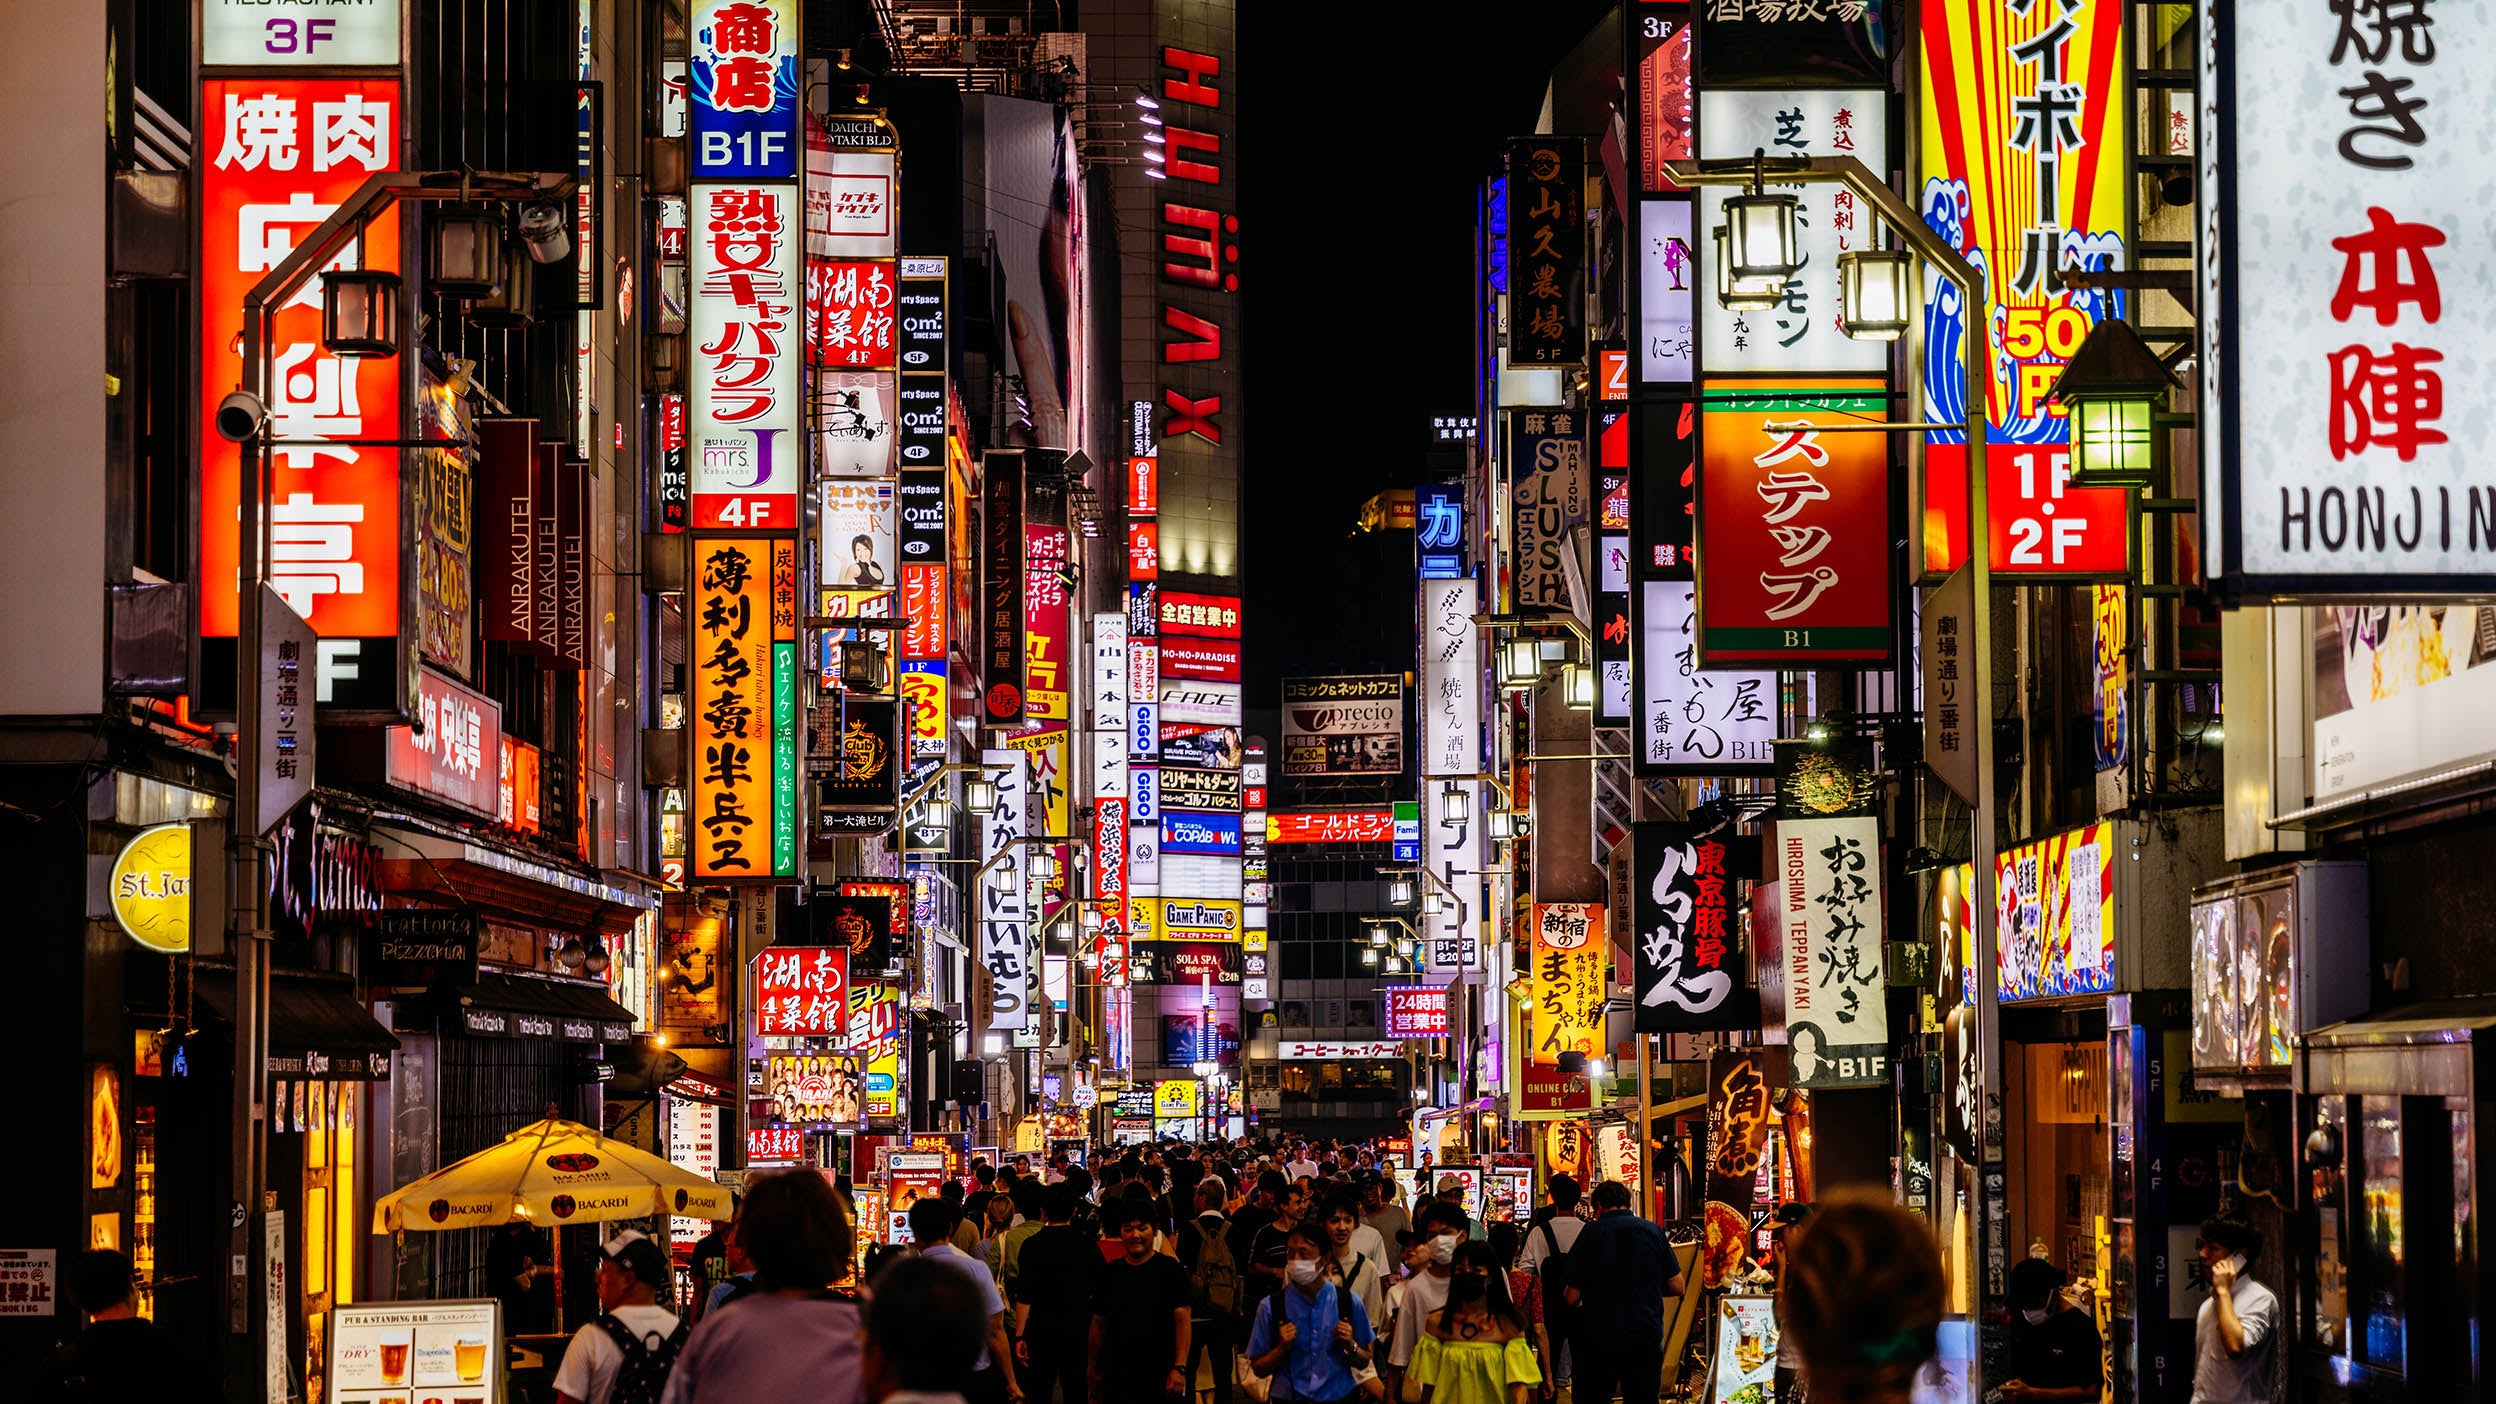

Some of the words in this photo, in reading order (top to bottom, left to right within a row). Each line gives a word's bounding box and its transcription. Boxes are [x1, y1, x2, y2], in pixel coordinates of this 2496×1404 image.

[265, 18, 336, 54] 3F
[1643, 17, 1673, 38] 3F
[712, 2, 776, 112] 商店
[214, 93, 391, 173] 焼肉
[831, 122, 877, 133] DAIICHI
[1833, 107, 1854, 158] 煮込
[701, 131, 787, 166] B1F
[866, 135, 892, 146] BLD
[834, 203, 884, 214] ラウンジ
[839, 191, 879, 203] カブキ
[1833, 191, 1854, 251] 肉刺し
[1527, 186, 1566, 341] 山久農場
[824, 264, 893, 308] 湖南
[699, 189, 793, 424] 熟女キャバクラ
[915, 295, 940, 305] Space
[913, 332, 929, 340] SINCE
[929, 332, 943, 340] 2007
[2327, 205, 2449, 463] 本陣
[846, 350, 871, 363] 4F
[909, 353, 924, 363] 5F
[1535, 348, 1561, 360] 5F
[915, 389, 940, 400] Space
[913, 427, 929, 435] SINCE
[929, 427, 943, 435] 2007
[1524, 414, 1573, 435] 麻雀
[1603, 414, 1616, 425] 4F
[703, 447, 750, 468] mrs.
[726, 428, 789, 488] J
[909, 447, 923, 457] 4F
[853, 463, 864, 472] 3F
[2013, 452, 2071, 499] 1F
[915, 485, 940, 495] Space
[1603, 477, 1619, 489] 3F
[718, 498, 771, 527] 4F
[1753, 418, 1839, 622] ステップ
[2280, 485, 2496, 553] HONJIN
[913, 522, 929, 530] SINCE
[929, 522, 943, 530] 2007
[910, 543, 924, 552] 3F
[2009, 517, 2088, 566] 2F
[512, 498, 529, 631] ANRAKUTEI
[1520, 511, 1536, 603] エスラッシュ
[539, 517, 555, 648] ANRAKUTEI
[773, 547, 795, 628] 炭火串焼
[929, 568, 941, 619] レンタルルーム
[565, 536, 581, 662] ANRAKUTEI
[906, 566, 924, 656] リフレッシュ
[1161, 602, 1238, 629] 全店営業中
[929, 623, 941, 653] ホステル
[1783, 630, 1812, 647] B1
[754, 643, 767, 680] Hakuri
[908, 662, 928, 672] 1F
[1161, 650, 1237, 664] MO-MO-PARADISE
[1145, 657, 1155, 693] カラオケ
[1936, 615, 1960, 753] 劇場通り一番街
[754, 682, 766, 706] tabai
[1161, 690, 1238, 707] FACE
[1286, 682, 1399, 697] コミック&ネットカフェ
[276, 638, 300, 780] 劇場通り一番街
[753, 706, 766, 742] hanbey
[1137, 706, 1151, 750] GiGO
[1339, 722, 1391, 730] アプレシオ
[1652, 698, 1674, 760] 一番街
[441, 694, 481, 782] 安楽亭
[1010, 733, 1065, 751] 今すぐ見つかる
[1731, 740, 1774, 760] B1F
[1160, 770, 1239, 792] ビリヤード&ダーツ
[1137, 772, 1151, 817] GiGO
[1211, 796, 1239, 808] バグース
[823, 815, 888, 827] 第一大滝ビル
[1099, 800, 1123, 892] 横浜家系
[1321, 828, 1383, 841] ハンバーグ
[1400, 846, 1412, 858] 酒
[1786, 837, 1806, 913] HIROSHIMA
[1166, 903, 1194, 924] GAME
[1196, 904, 1224, 925] PANIC
[1694, 839, 1728, 969] 東京豚骨
[1133, 922, 1150, 930] PANIC
[1543, 912, 1587, 937] 新宿
[1814, 834, 1880, 1025] お好み焼き
[1558, 935, 1573, 947] の
[761, 949, 842, 993] 湖南
[1176, 954, 1199, 965] SOLA
[1200, 955, 1218, 965] SPA
[1587, 951, 1600, 996] 博多もつ鍋
[1395, 994, 1446, 1011] 24時間
[1541, 950, 1575, 1052] まっちゃん
[1574, 953, 1587, 1029] 九州のうまかもん
[761, 997, 778, 1032] 4F
[1395, 1013, 1446, 1030] 営業中
[1838, 1056, 1886, 1079] B1F
[2150, 1060, 2160, 1092] 5F
[1527, 1083, 1559, 1094] ONLINE
[868, 1103, 890, 1114] 3F
[1551, 1097, 1562, 1107] B1
[1718, 1063, 1767, 1176] 角煮
[919, 1172, 941, 1180] relaxing
[2151, 1158, 2161, 1191] 4F
[2154, 1255, 2166, 1288] 3F
[344, 1315, 361, 1324] PUB
[363, 1315, 368, 1323] &
[370, 1314, 410, 1323] STANDING
[412, 1313, 428, 1321] BAR
